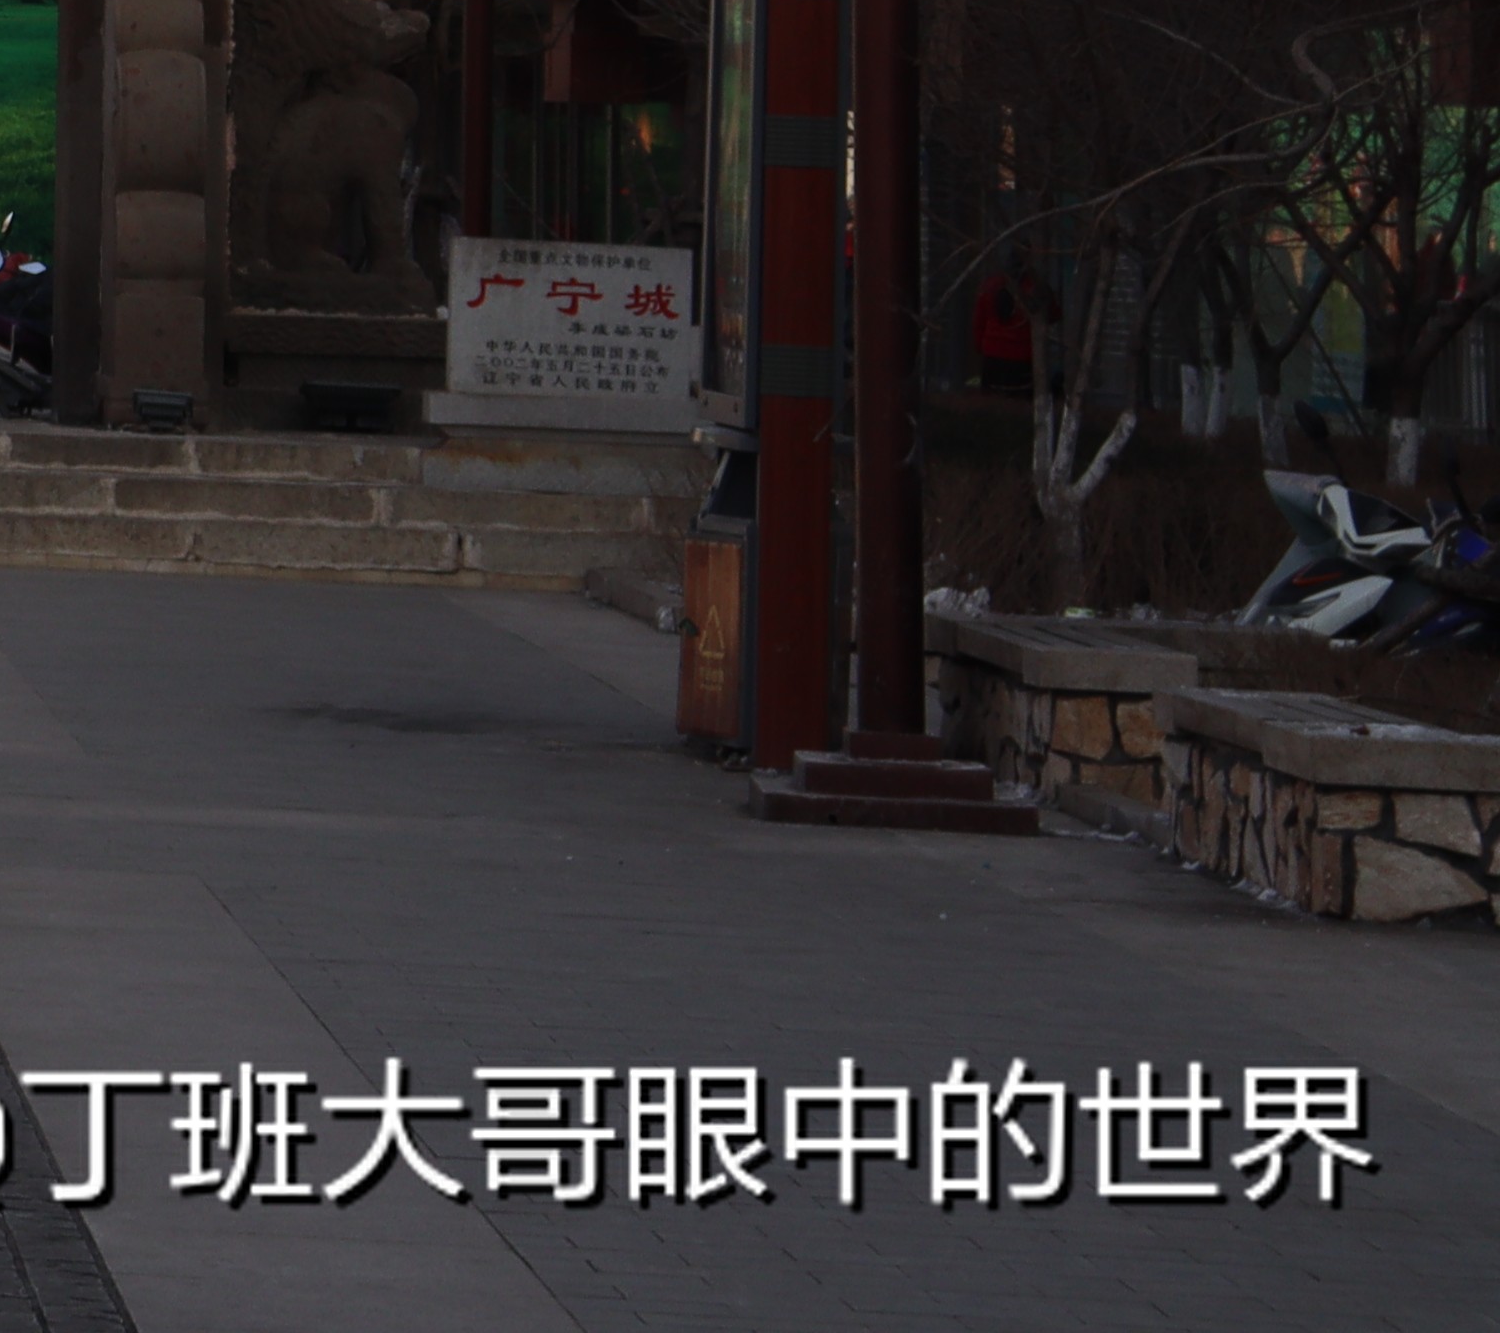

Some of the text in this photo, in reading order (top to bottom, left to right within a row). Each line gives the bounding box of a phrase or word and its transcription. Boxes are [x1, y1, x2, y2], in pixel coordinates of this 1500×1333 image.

[498, 248, 653, 271] 全国重点文物保护单位
[466, 273, 680, 320] 广宁城
